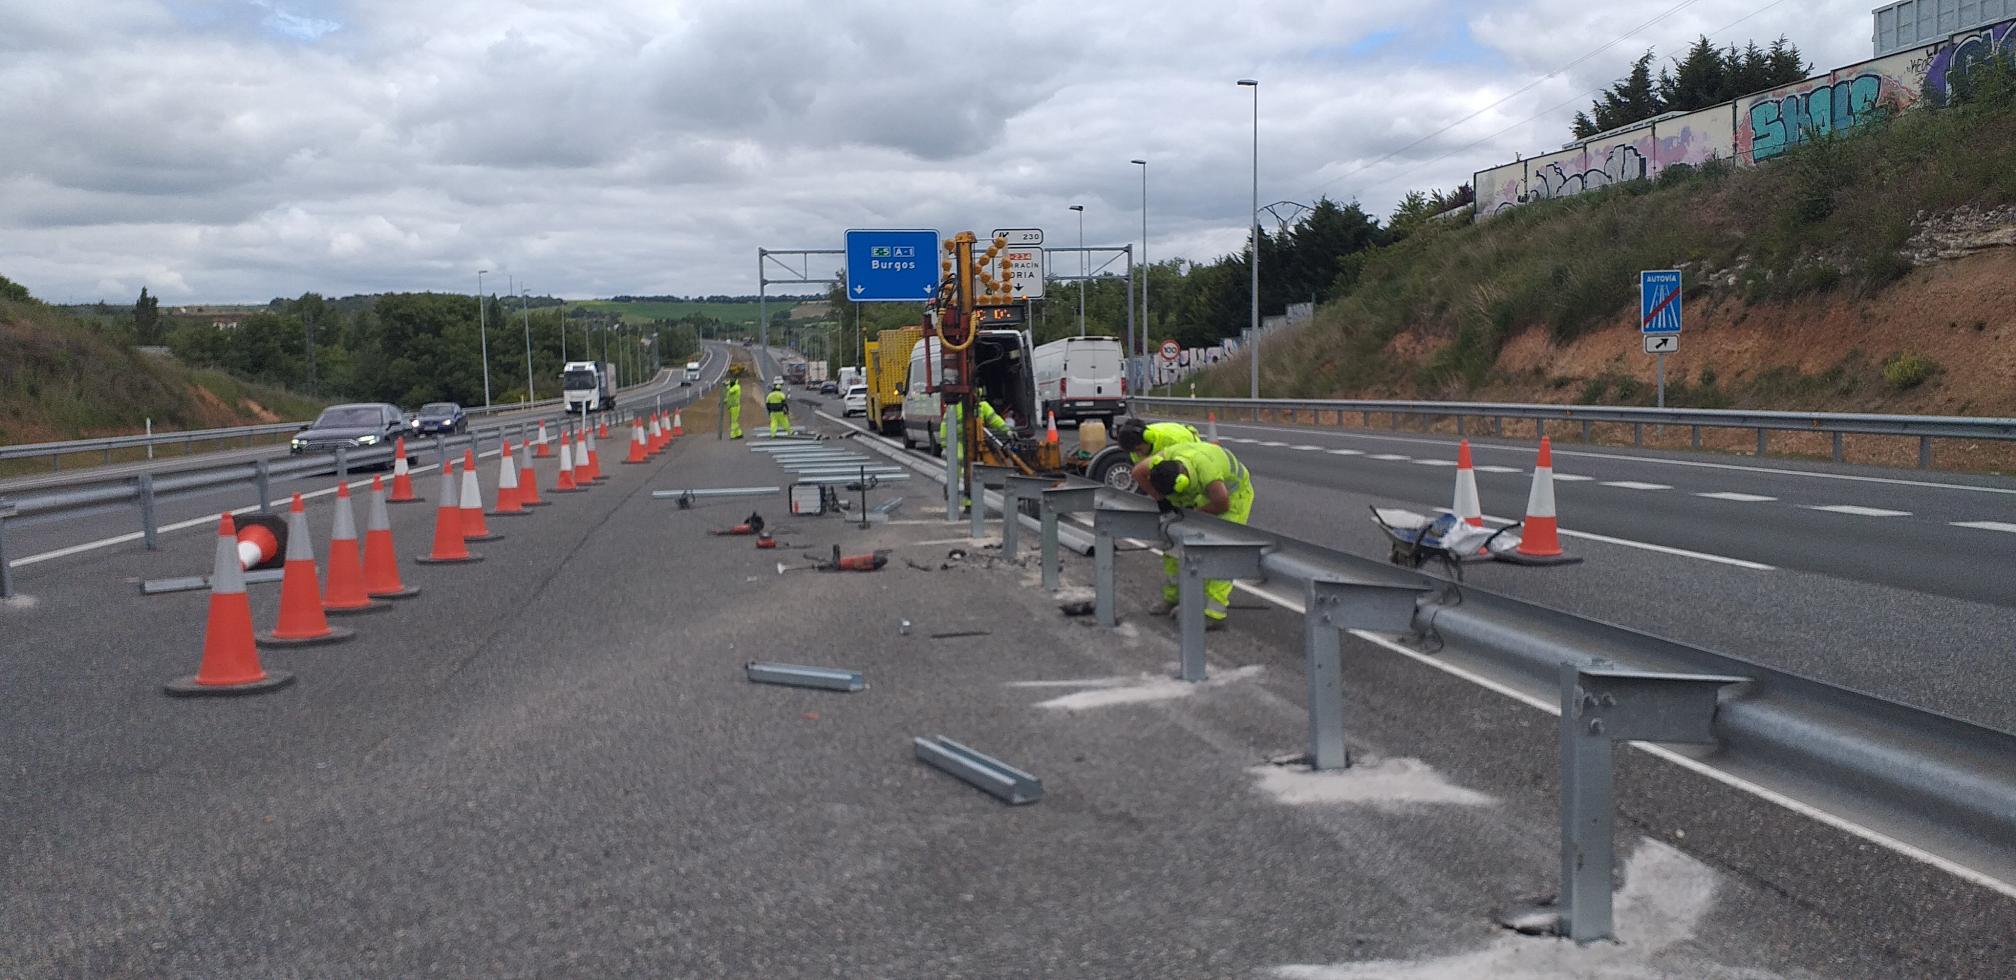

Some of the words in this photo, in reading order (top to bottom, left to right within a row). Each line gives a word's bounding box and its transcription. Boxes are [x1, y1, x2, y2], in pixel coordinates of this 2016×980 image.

[1023, 233, 1040, 241] 230
[873, 248, 889, 256] E-5
[896, 248, 913, 256] A-1
[871, 260, 915, 271] Burgos
[1010, 271, 1034, 279] ORIA
